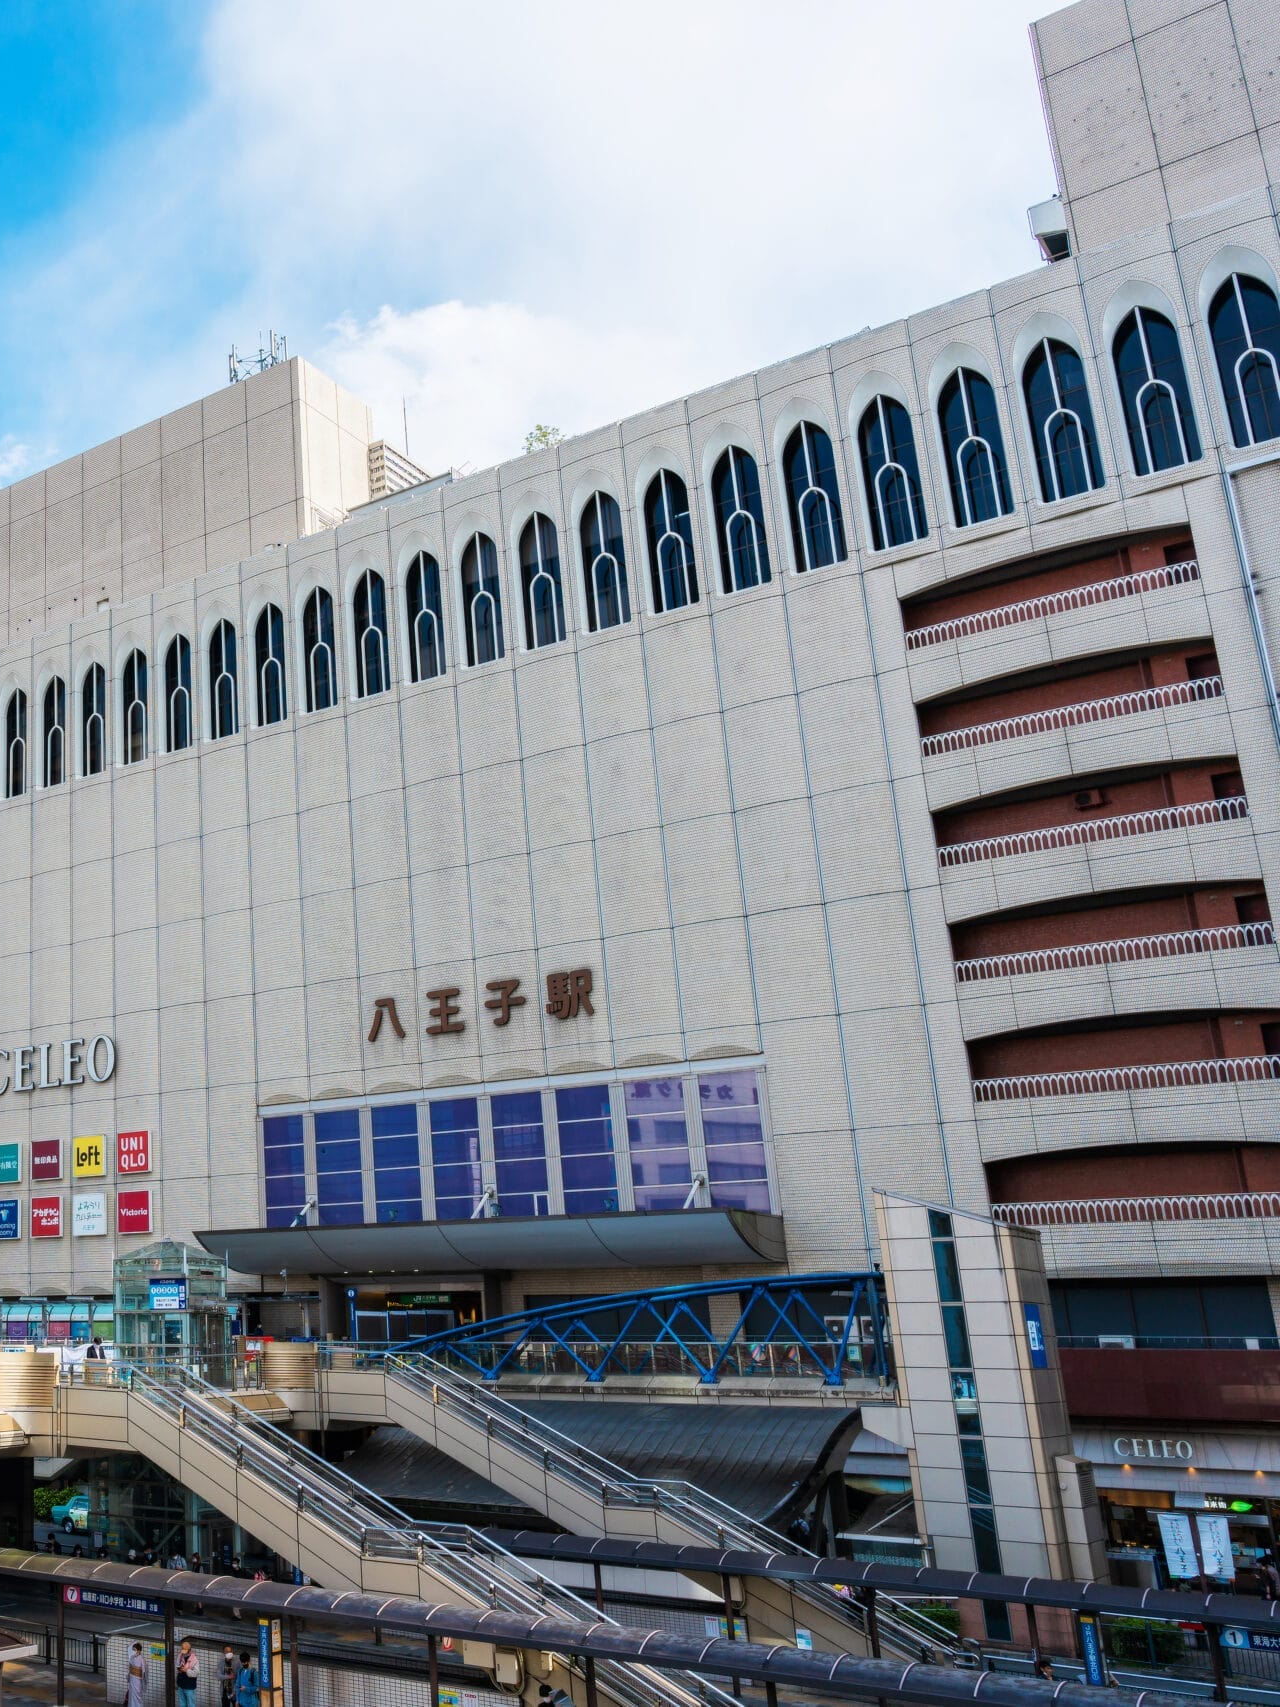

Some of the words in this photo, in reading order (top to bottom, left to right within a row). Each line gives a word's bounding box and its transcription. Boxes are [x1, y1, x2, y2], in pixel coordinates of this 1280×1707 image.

[368, 968, 595, 1043] 八王子駅
[120, 1136, 144, 1151] UNI
[34, 1155, 58, 1165] 無印良品
[121, 1153, 146, 1169] QLO
[32, 1208, 59, 1217] アカチャン
[120, 1207, 148, 1216] Victoria
[41, 1217, 59, 1226] ホンポ
[1114, 1437, 1193, 1459] CELEO
[1229, 1631, 1238, 1645] 1
[1253, 1635, 1280, 1648] 東海大
